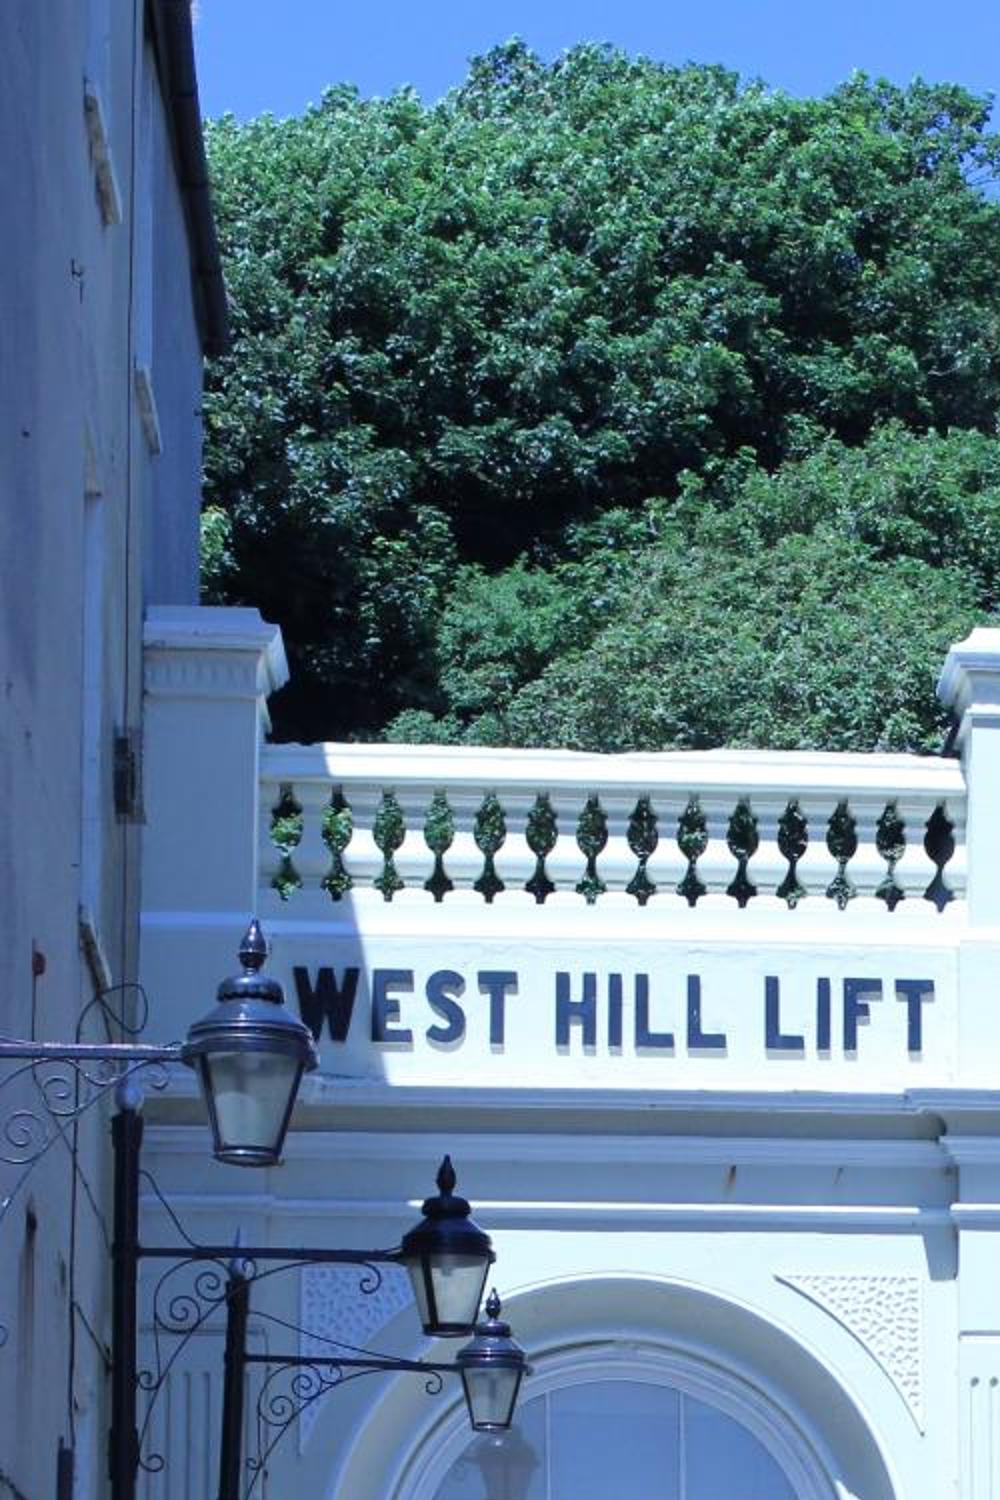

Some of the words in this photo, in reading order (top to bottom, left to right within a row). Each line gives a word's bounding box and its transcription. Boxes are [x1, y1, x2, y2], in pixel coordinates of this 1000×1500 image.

[293, 966, 518, 1046] WEST
[555, 971, 727, 1050] HILL
[764, 975, 935, 1052] LIFT
